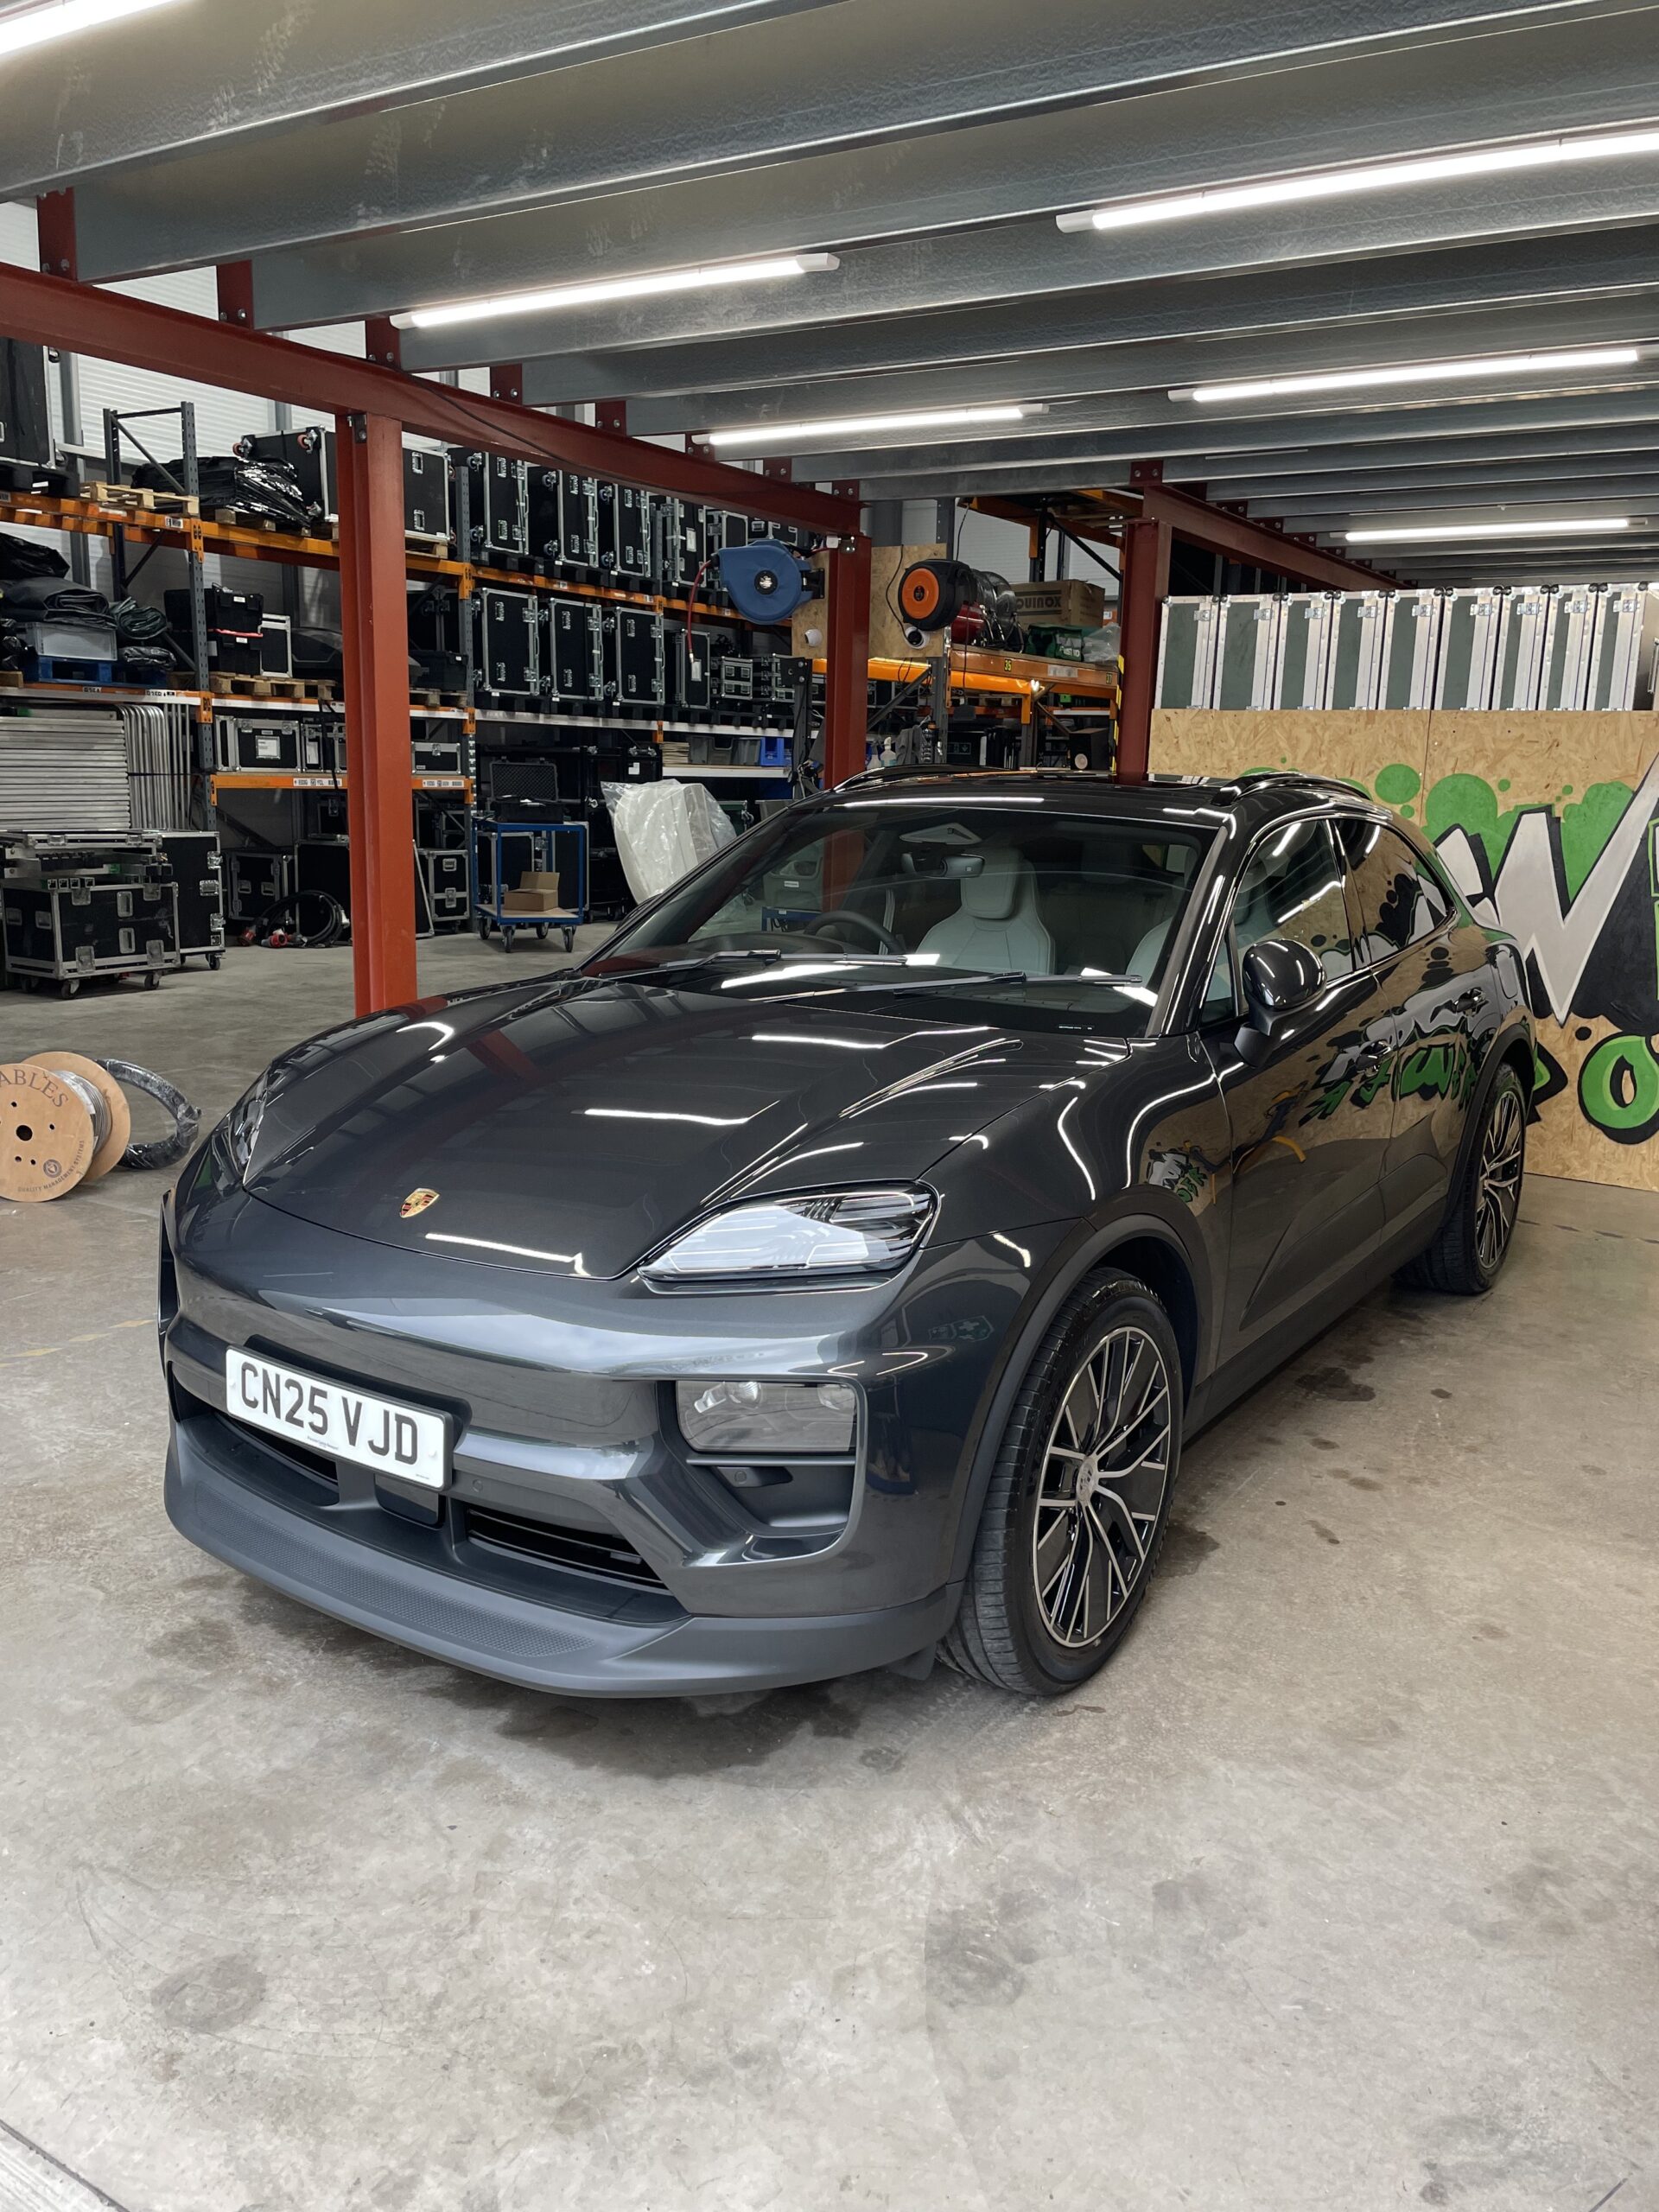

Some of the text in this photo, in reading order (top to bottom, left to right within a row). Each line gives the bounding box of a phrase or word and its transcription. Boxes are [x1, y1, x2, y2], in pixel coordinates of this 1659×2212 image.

[1014, 595, 1061, 610] QUINOX
[1004, 659, 1012, 671] 35
[0, 1069, 69, 1107] ABLES
[43, 1166, 75, 1190] MANAGEMENT
[73, 1140, 85, 1165] SYSTEMS
[241, 1362, 418, 1465] CN25 VJD
